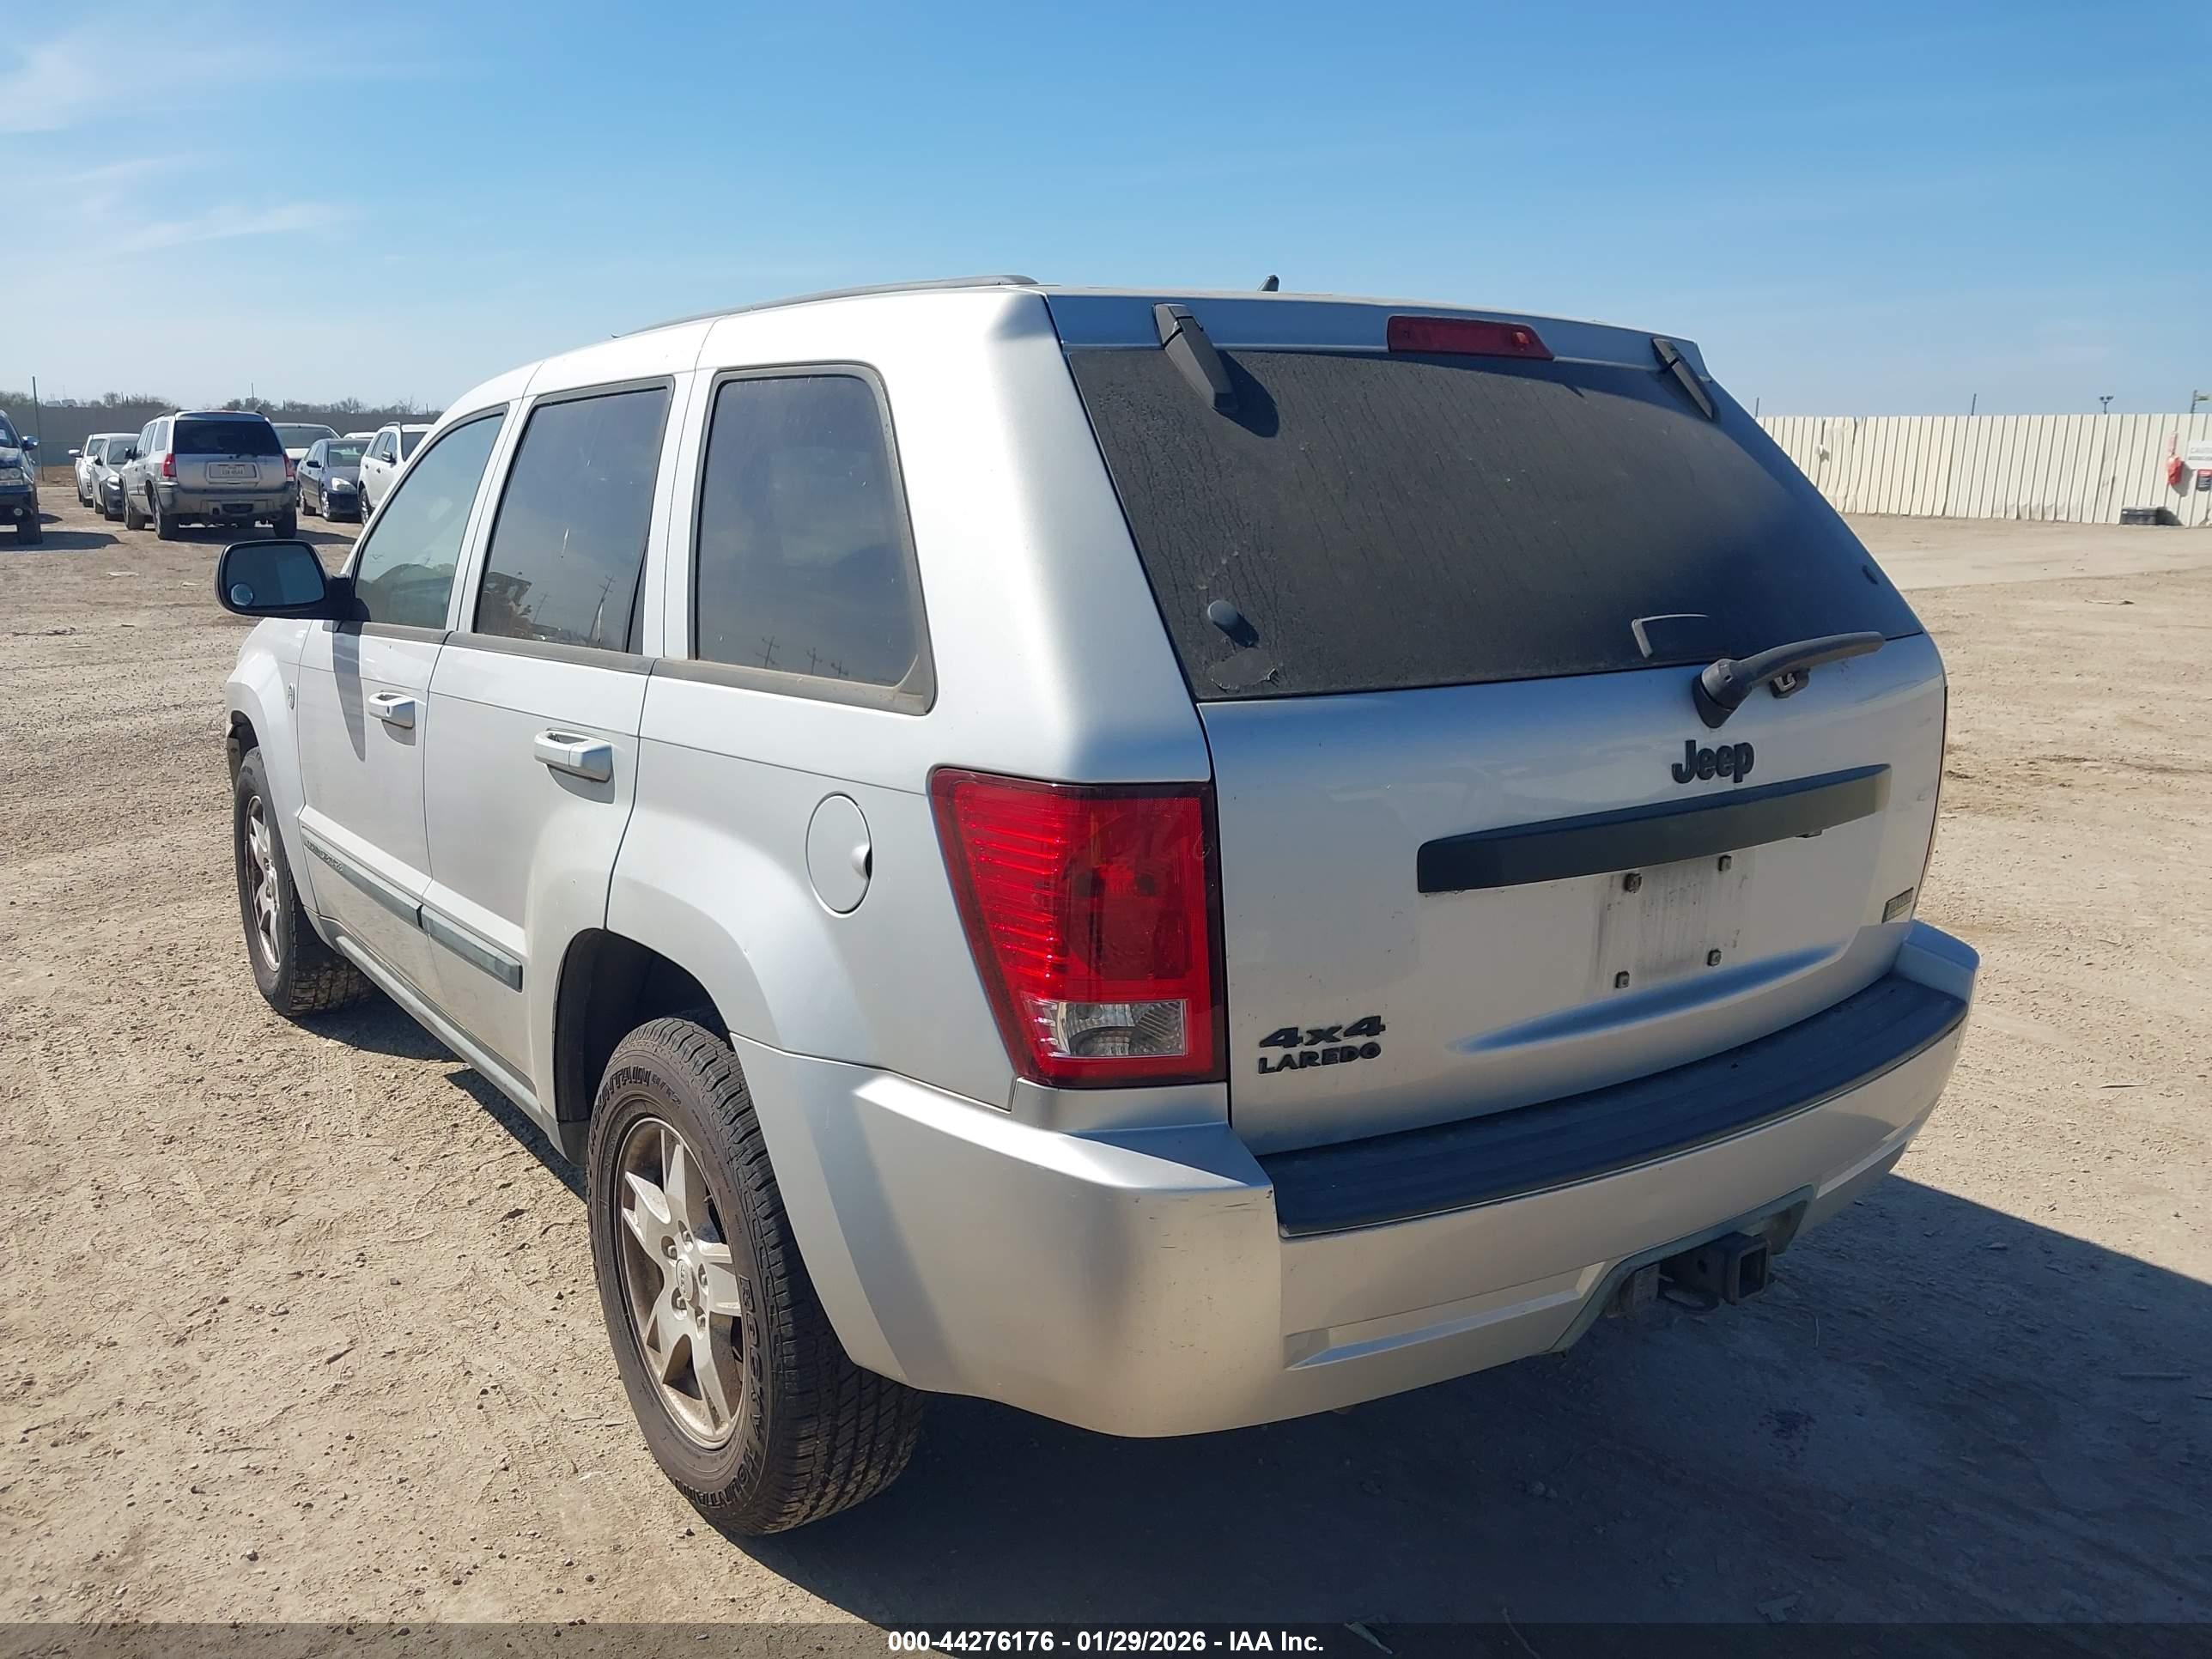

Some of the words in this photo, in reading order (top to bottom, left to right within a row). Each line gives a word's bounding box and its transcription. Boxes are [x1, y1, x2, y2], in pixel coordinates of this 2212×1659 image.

[1671, 739, 1754, 784] Jeep
[1259, 1015, 1386, 1048] 4x4
[1258, 1042, 1382, 1074] LAREDO
